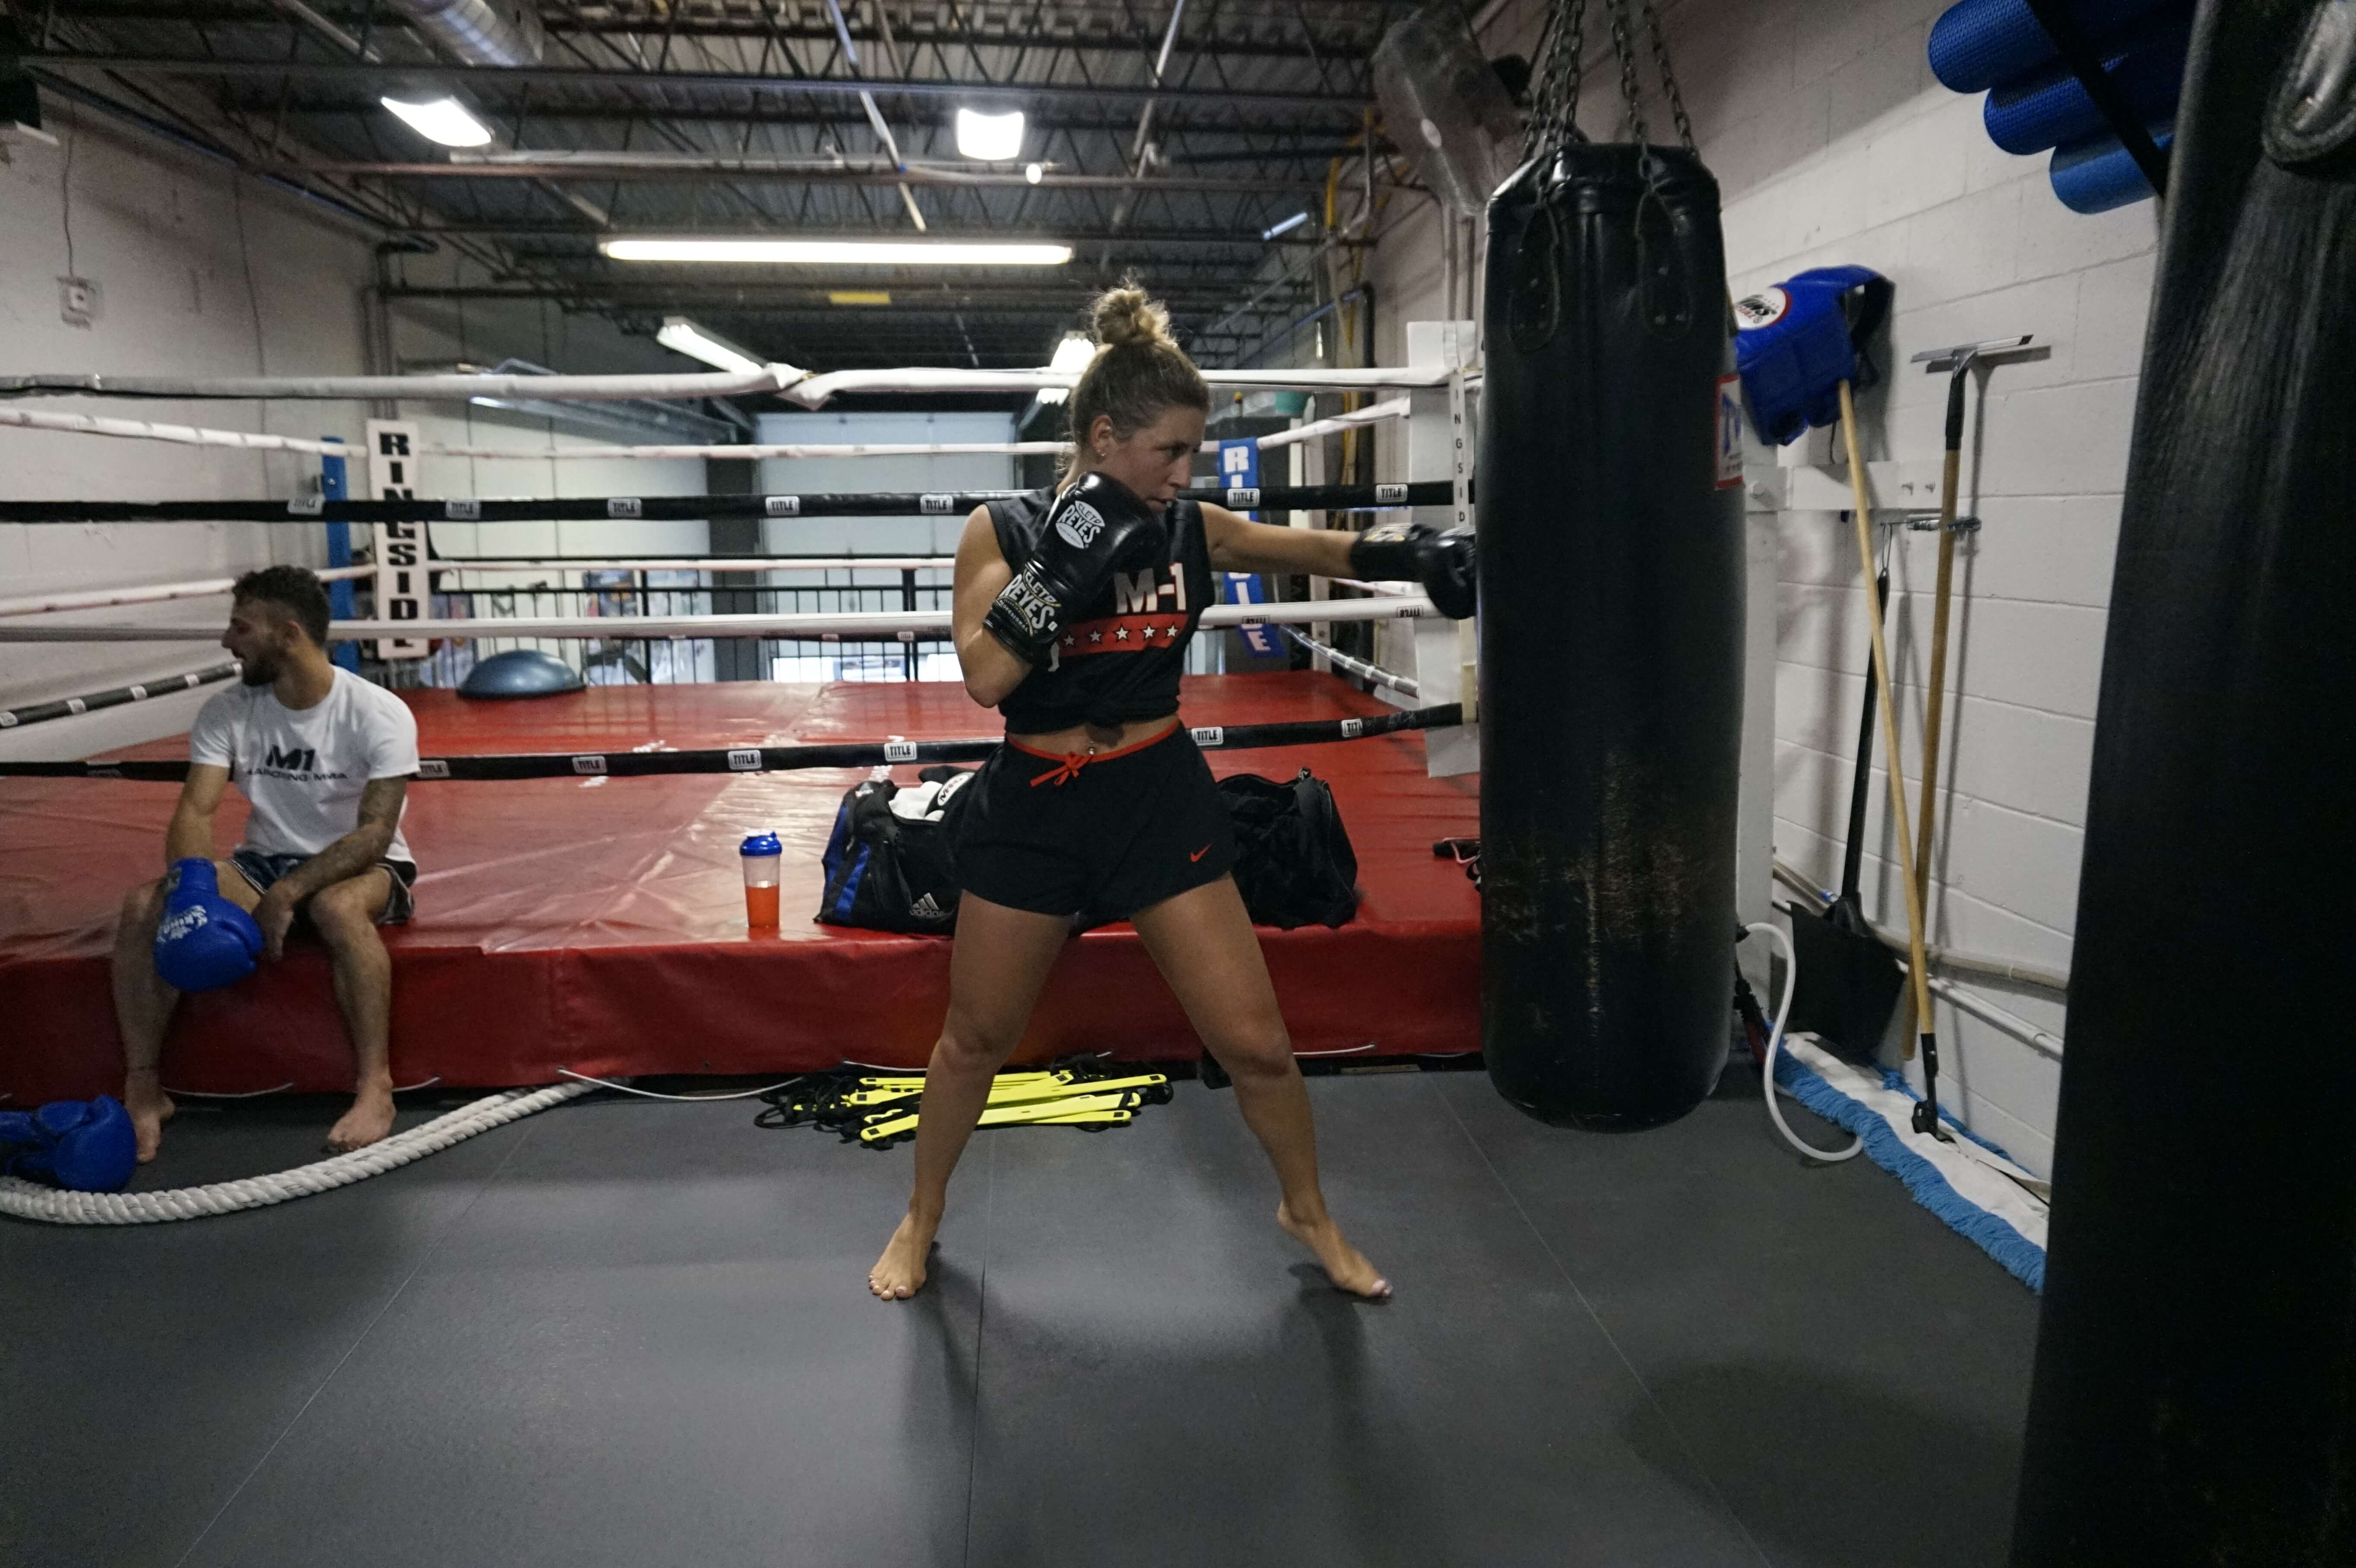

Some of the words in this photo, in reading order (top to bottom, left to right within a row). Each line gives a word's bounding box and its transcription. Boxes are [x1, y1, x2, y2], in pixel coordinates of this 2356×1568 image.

[1453, 367, 1466, 522] RINGSID
[1232, 491, 1254, 503] TITLE
[1381, 487, 1402, 498] TITLE
[613, 503, 635, 513] TITLE
[770, 500, 793, 511] TITLE
[925, 499, 947, 510] TITLE
[1078, 503, 1102, 524] CLETO
[1056, 504, 1101, 543] REYES
[1114, 562, 1187, 613] M-1
[998, 573, 1055, 629] REYES
[1196, 729, 1218, 740] TITLE
[890, 745, 911, 756] TITLE
[265, 744, 316, 771] M1
[733, 754, 755, 764] TITLE
[578, 760, 600, 769] TITLE
